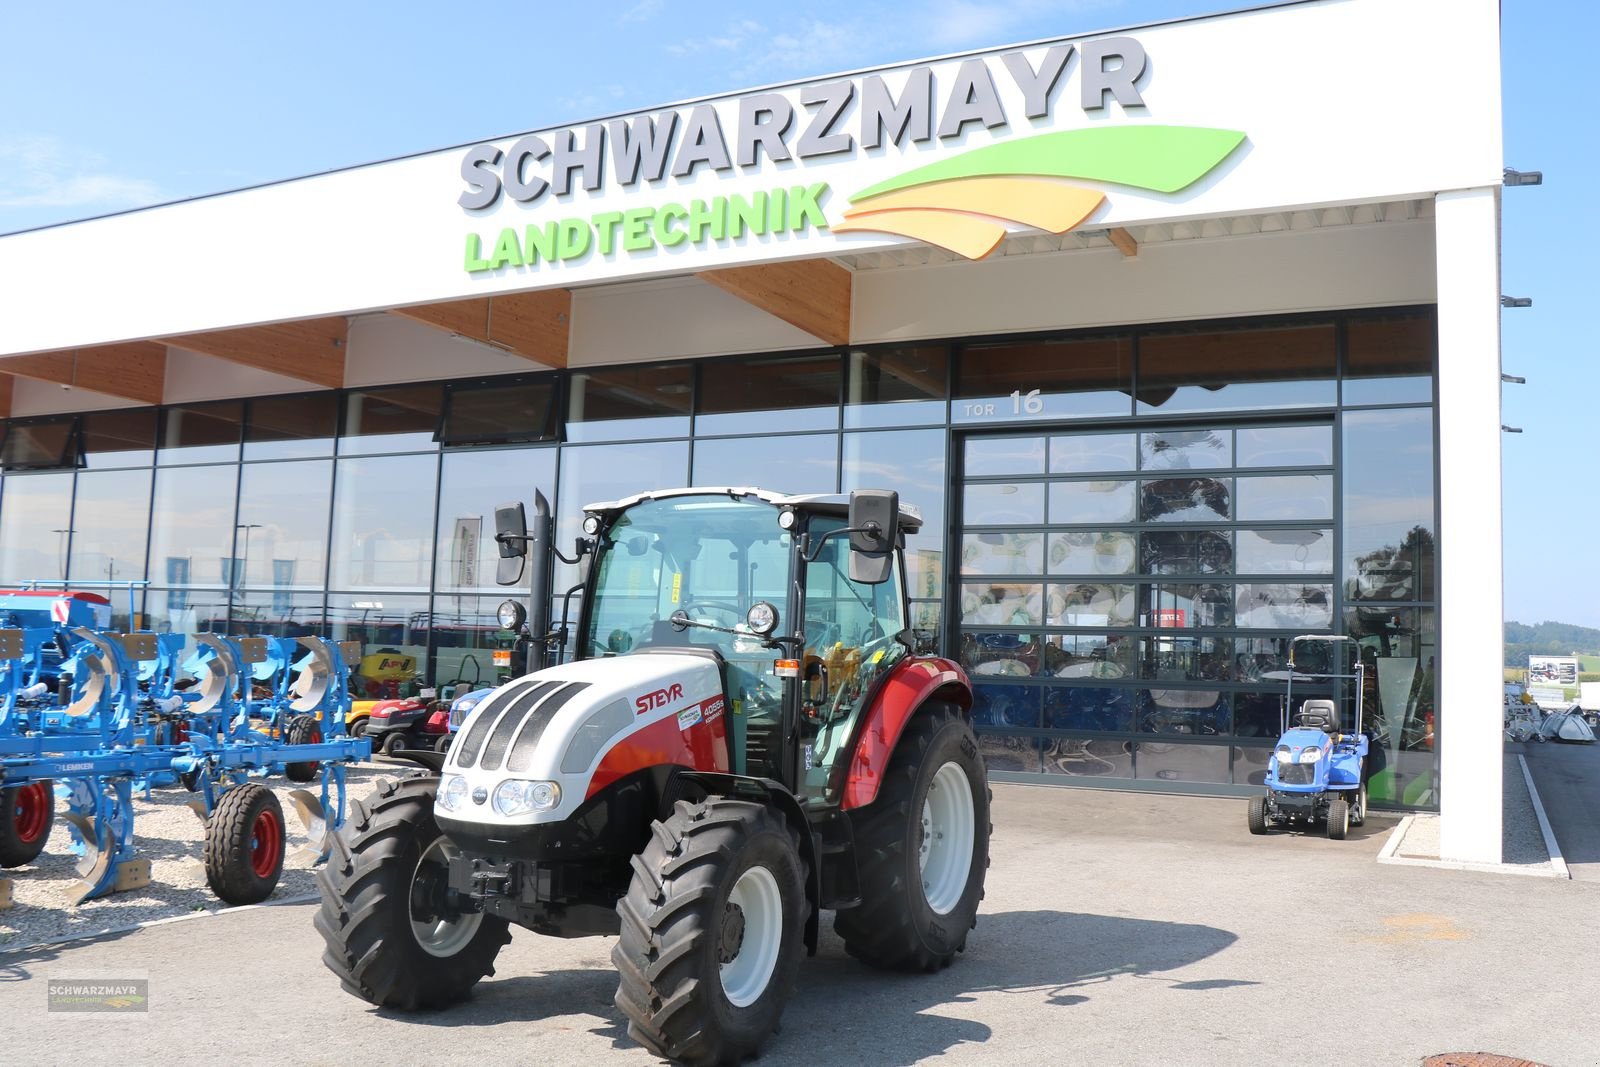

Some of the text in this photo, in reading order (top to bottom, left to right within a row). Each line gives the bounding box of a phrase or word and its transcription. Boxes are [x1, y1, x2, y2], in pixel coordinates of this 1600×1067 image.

[457, 37, 1148, 209] SCHWARZMAYR
[463, 182, 831, 272] LANDTECHNIK
[964, 388, 1043, 417] TOR 16
[635, 683, 684, 715] STEYR
[62, 763, 94, 771] LEMKEN
